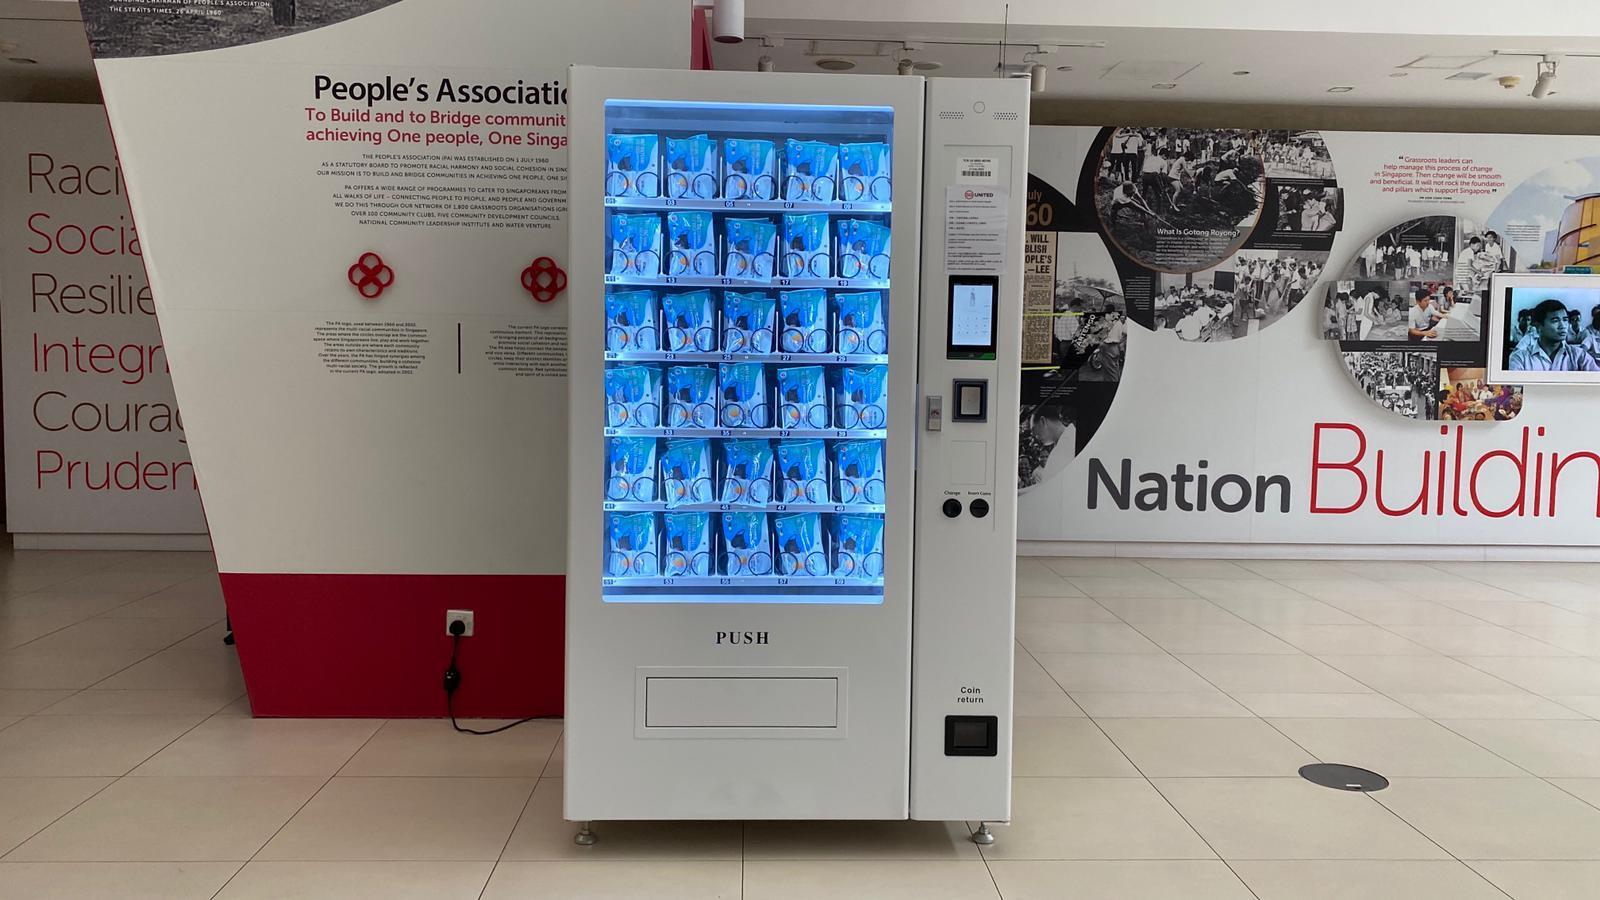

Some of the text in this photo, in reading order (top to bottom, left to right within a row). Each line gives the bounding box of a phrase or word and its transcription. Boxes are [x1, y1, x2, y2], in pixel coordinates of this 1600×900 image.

[314, 76, 428, 107] People's
[305, 108, 326, 121] To
[331, 108, 370, 122] Build
[375, 110, 404, 123] and
[409, 112, 426, 123] to
[431, 110, 480, 127] Bridge
[306, 128, 382, 145] achieving
[388, 130, 420, 143] One
[426, 130, 483, 147] people,
[489, 132, 521, 145] One
[1026, 203, 1053, 226] 60
[1031, 234, 1049, 243] WILL
[1183, 229, 1209, 237] Gotong
[1211, 229, 1240, 237] Royong?
[1025, 245, 1047, 253] BLISH
[36, 450, 197, 490] Pruden
[1087, 422, 1600, 518] Nation Buildin
[716, 632, 768, 645] PUSH
